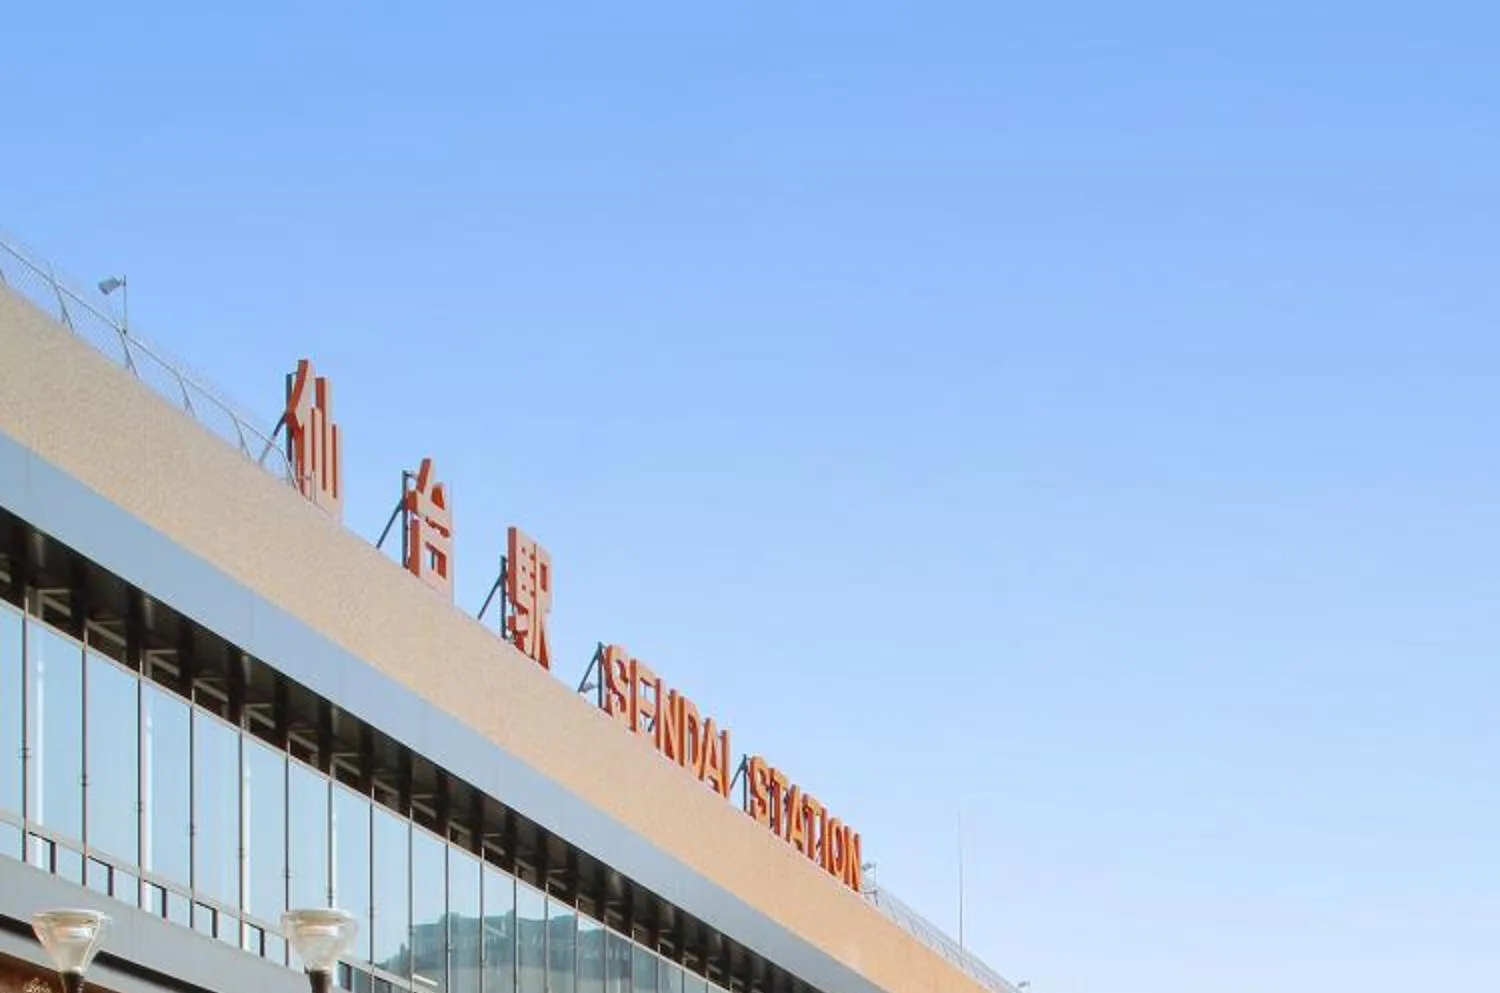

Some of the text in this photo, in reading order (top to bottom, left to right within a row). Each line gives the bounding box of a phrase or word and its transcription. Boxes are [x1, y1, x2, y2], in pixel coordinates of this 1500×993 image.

[286, 358, 553, 670] 仙台駅
[603, 644, 863, 890] SENDAI STATION
